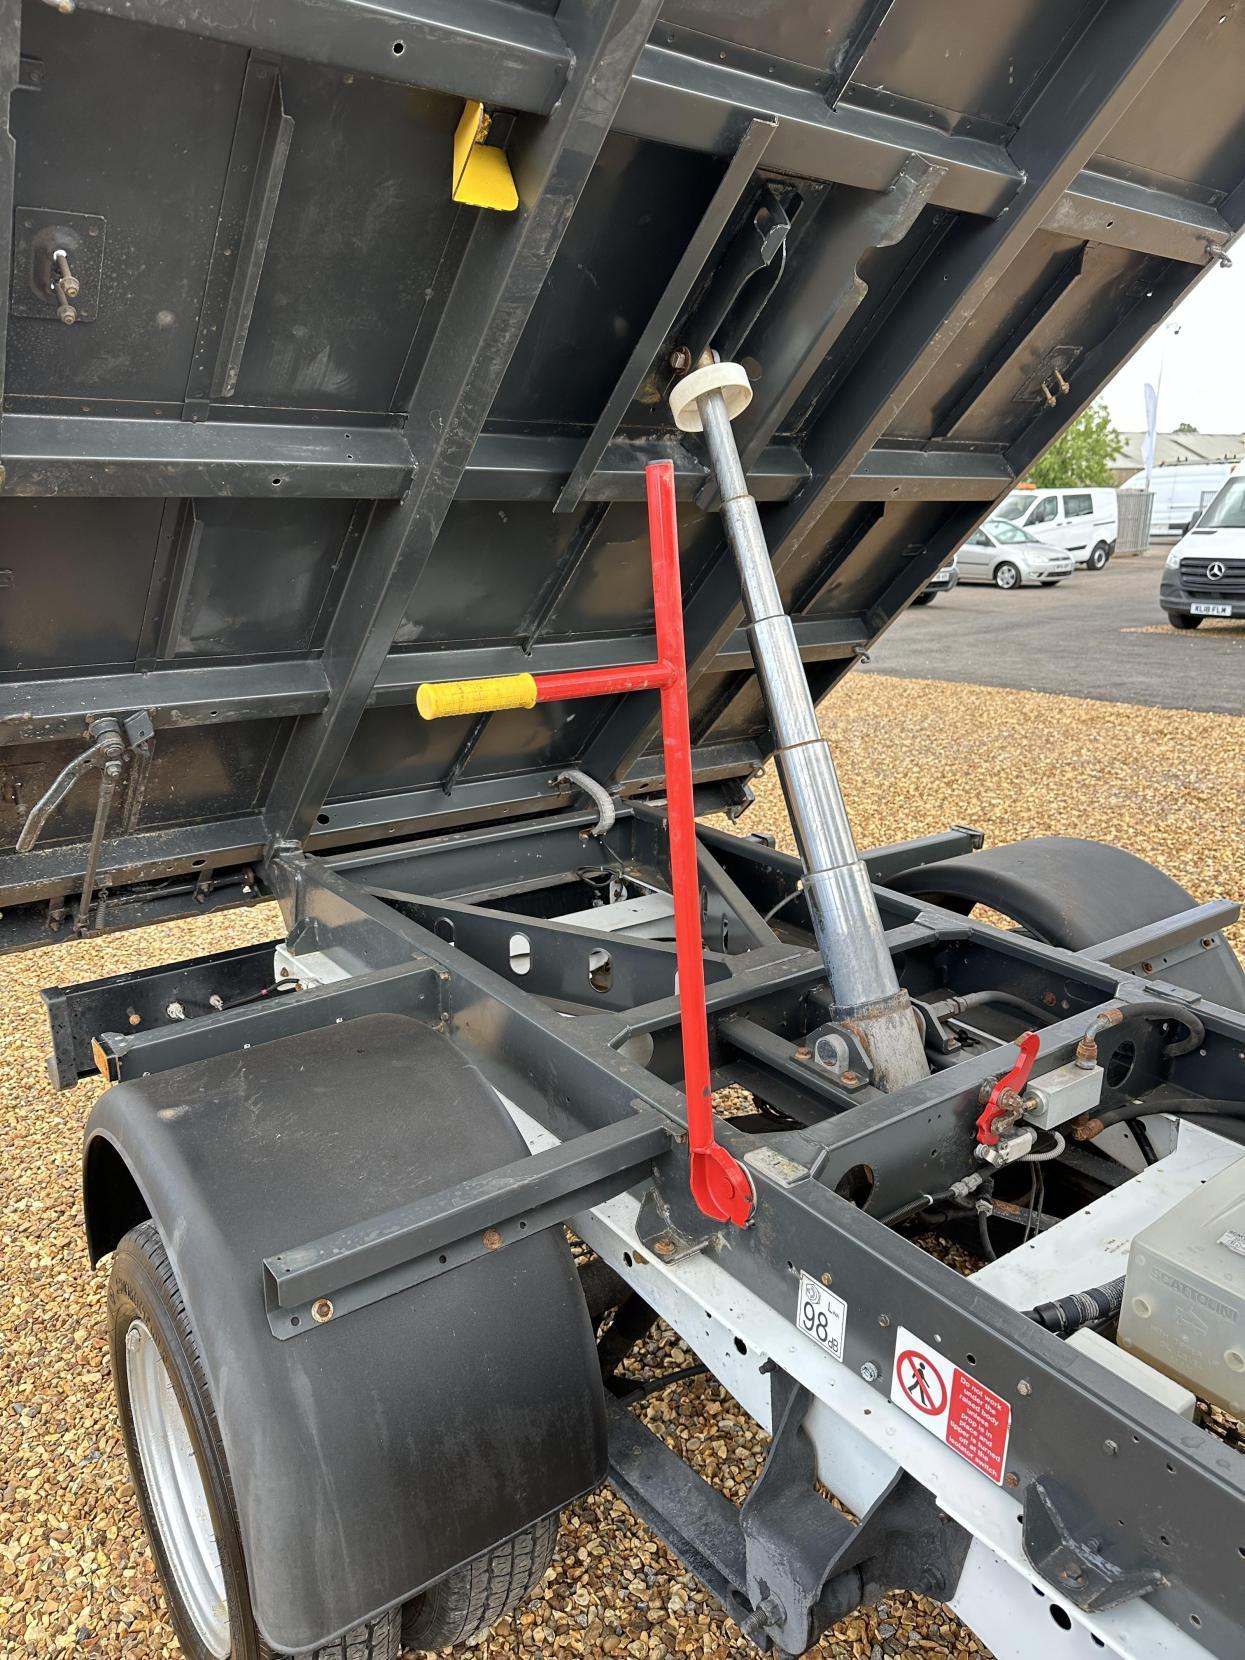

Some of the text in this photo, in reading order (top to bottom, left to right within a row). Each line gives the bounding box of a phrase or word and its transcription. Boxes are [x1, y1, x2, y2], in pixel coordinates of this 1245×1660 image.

[803, 1301, 828, 1342] 98
[960, 1376, 1002, 1411] Do not work
[963, 1388, 997, 1415] under the
[960, 1394, 999, 1426] raised body
[966, 1407, 989, 1427] unless
[959, 1420, 993, 1447] place and
[961, 1413, 993, 1439] prop is in
[950, 1420, 1001, 1463] tipper is turned
[959, 1436, 989, 1462] off at the
[949, 1435, 998, 1478] isolator switch
